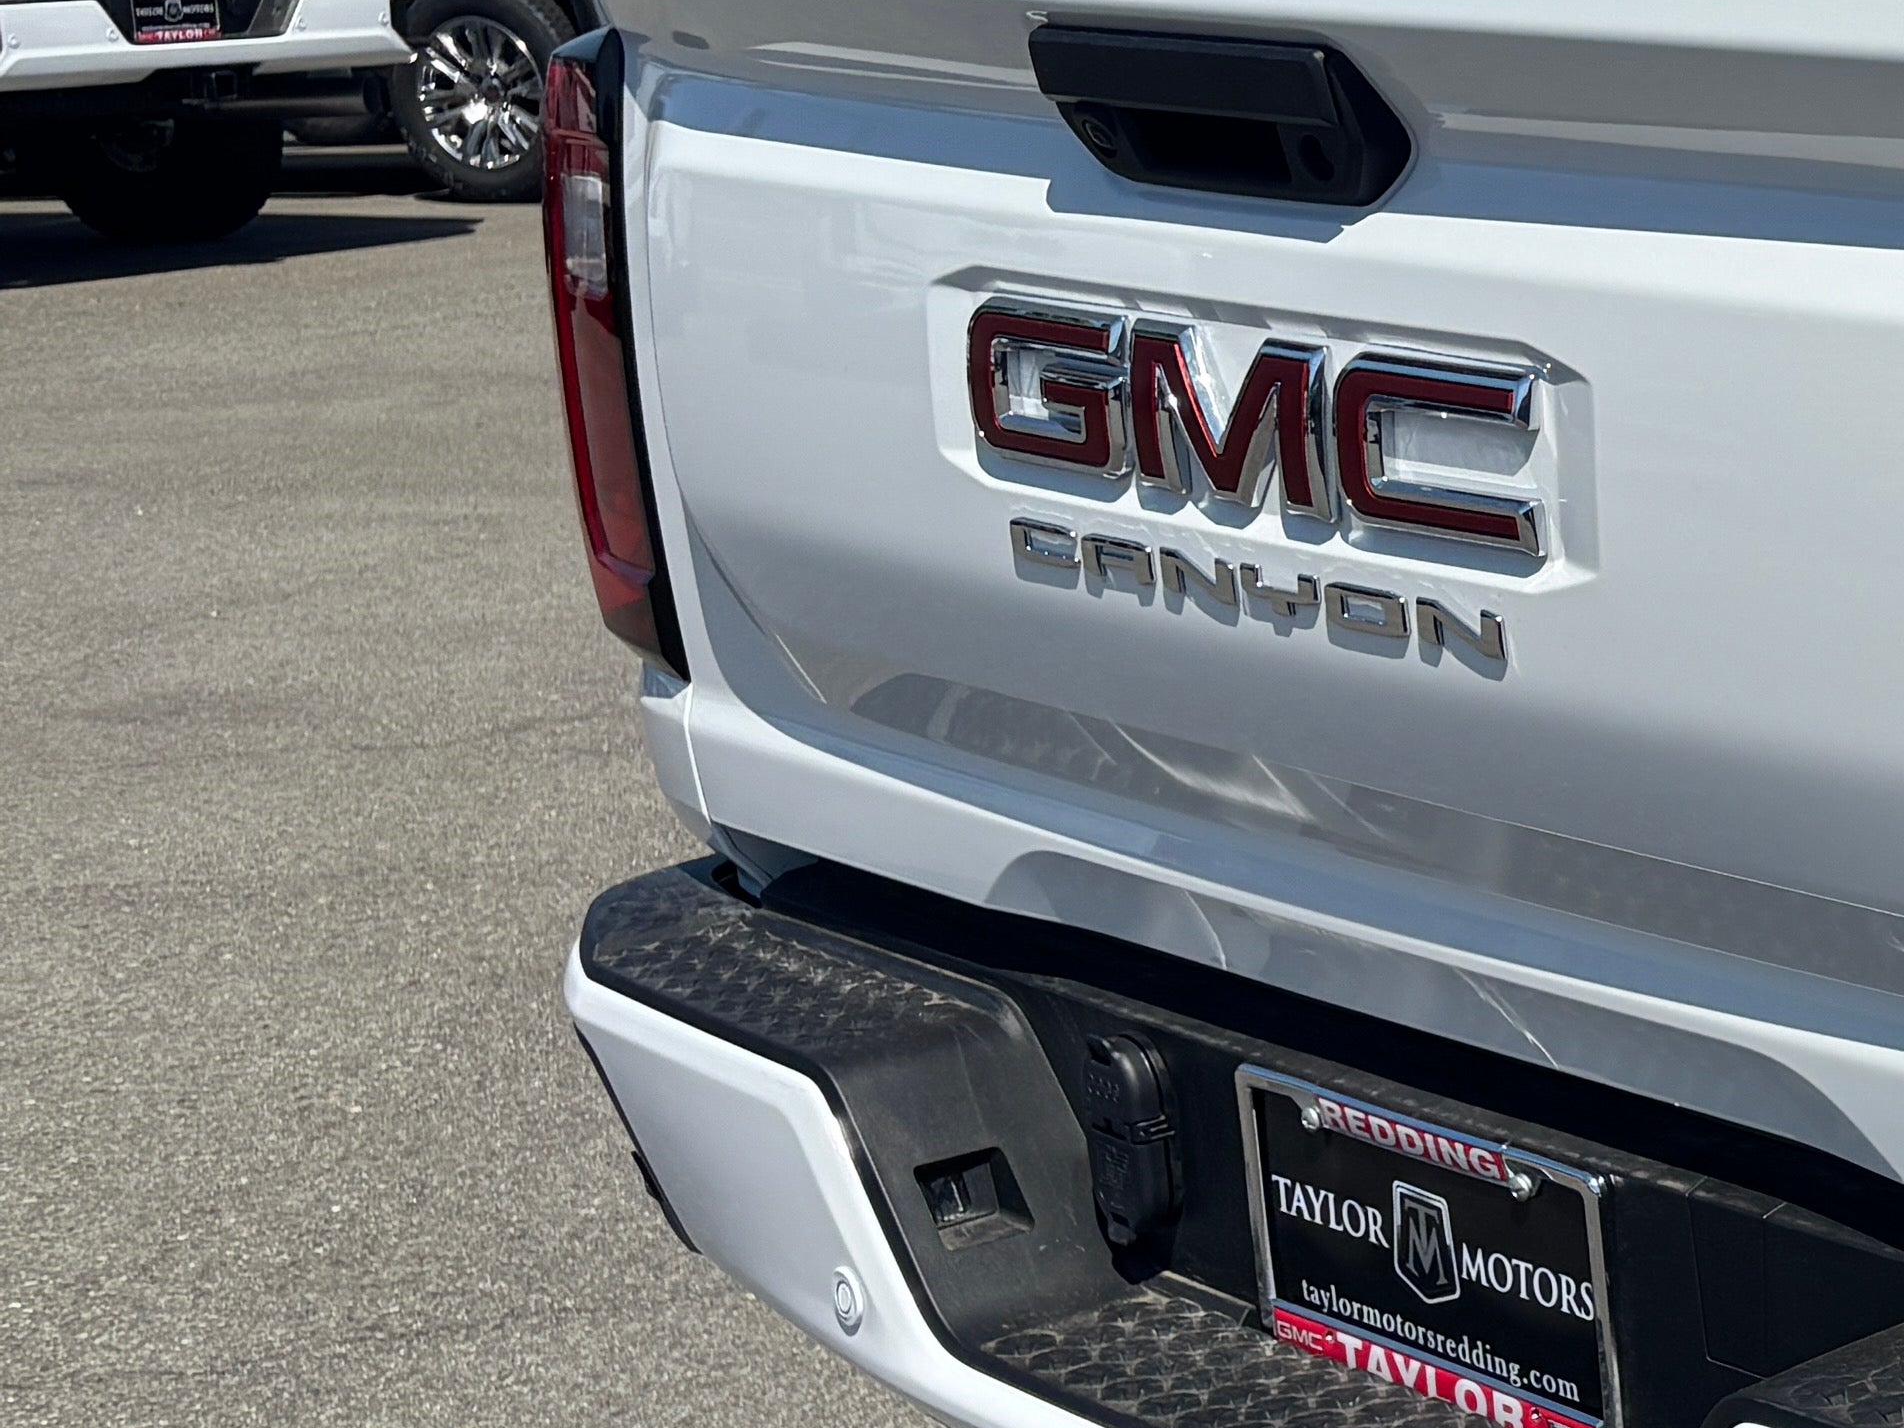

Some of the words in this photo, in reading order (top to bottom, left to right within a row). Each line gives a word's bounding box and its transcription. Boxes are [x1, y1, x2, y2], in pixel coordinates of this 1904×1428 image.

[967, 296, 1547, 557] GMC
[1009, 516, 1509, 661] CANYON
[1317, 1097, 1503, 1177] REDDING
[1272, 1174, 1390, 1248] TAYLOR
[1461, 1242, 1596, 1322] MOTORS
[1276, 1320, 1323, 1351] GMC
[1301, 1278, 1581, 1403] taylormotorsredding.com
